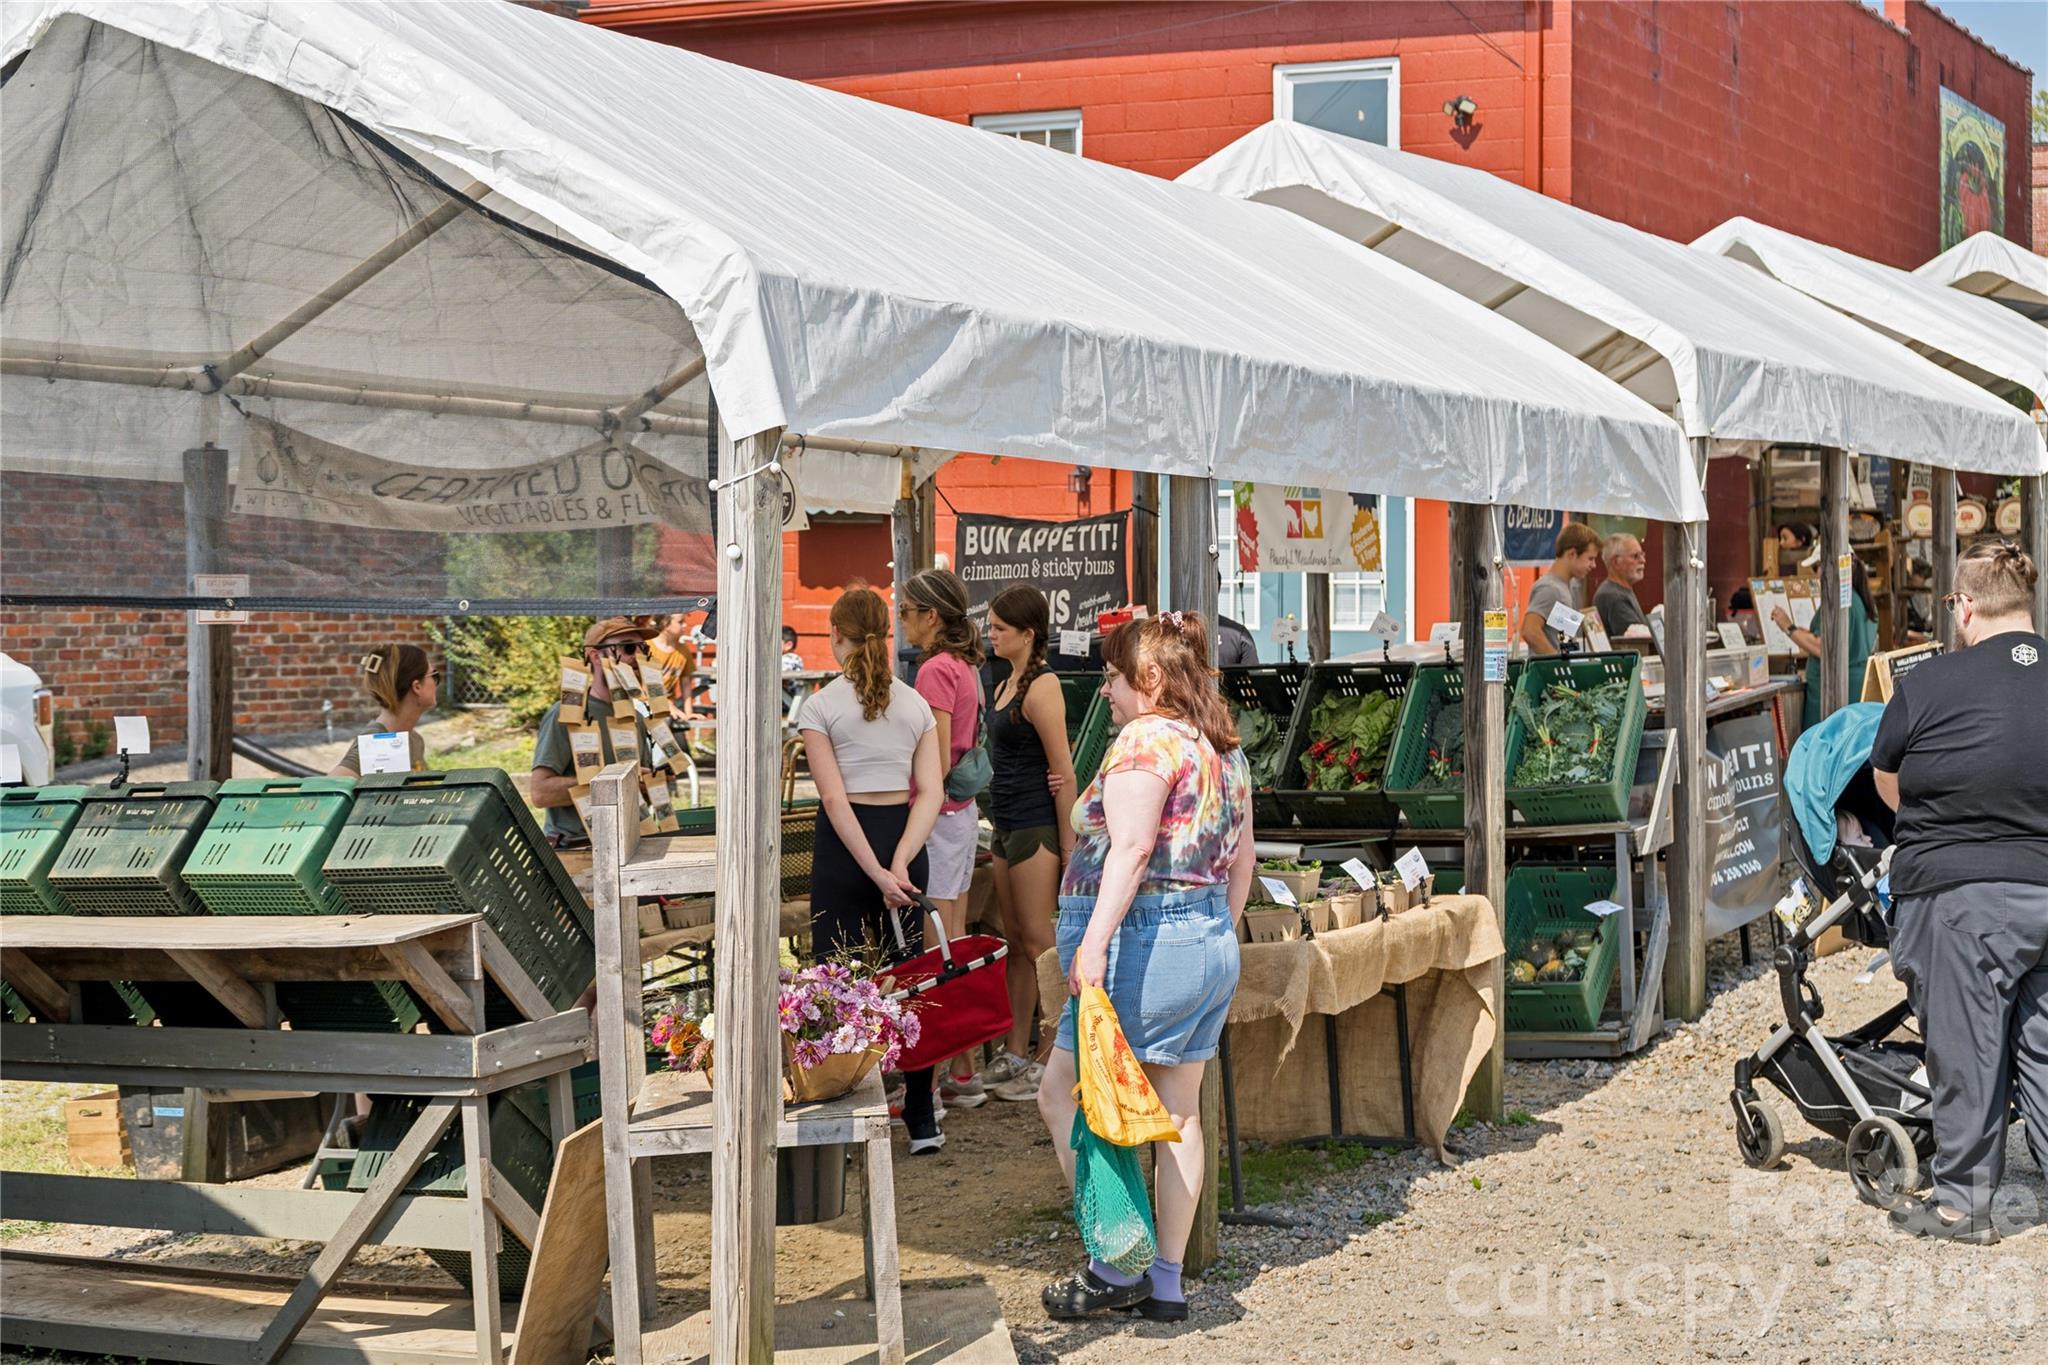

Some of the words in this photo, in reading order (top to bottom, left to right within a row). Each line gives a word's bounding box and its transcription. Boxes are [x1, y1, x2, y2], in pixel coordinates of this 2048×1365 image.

[456, 497, 588, 526] VEGETABLES
[596, 497, 612, 520] &
[964, 525, 1014, 556] BUN
[1016, 523, 1119, 554] APPETIT!
[962, 560, 1029, 582] cinnamon
[1031, 558, 1041, 578] &
[1042, 556, 1083, 581] sticky
[1084, 557, 1115, 576] buns
